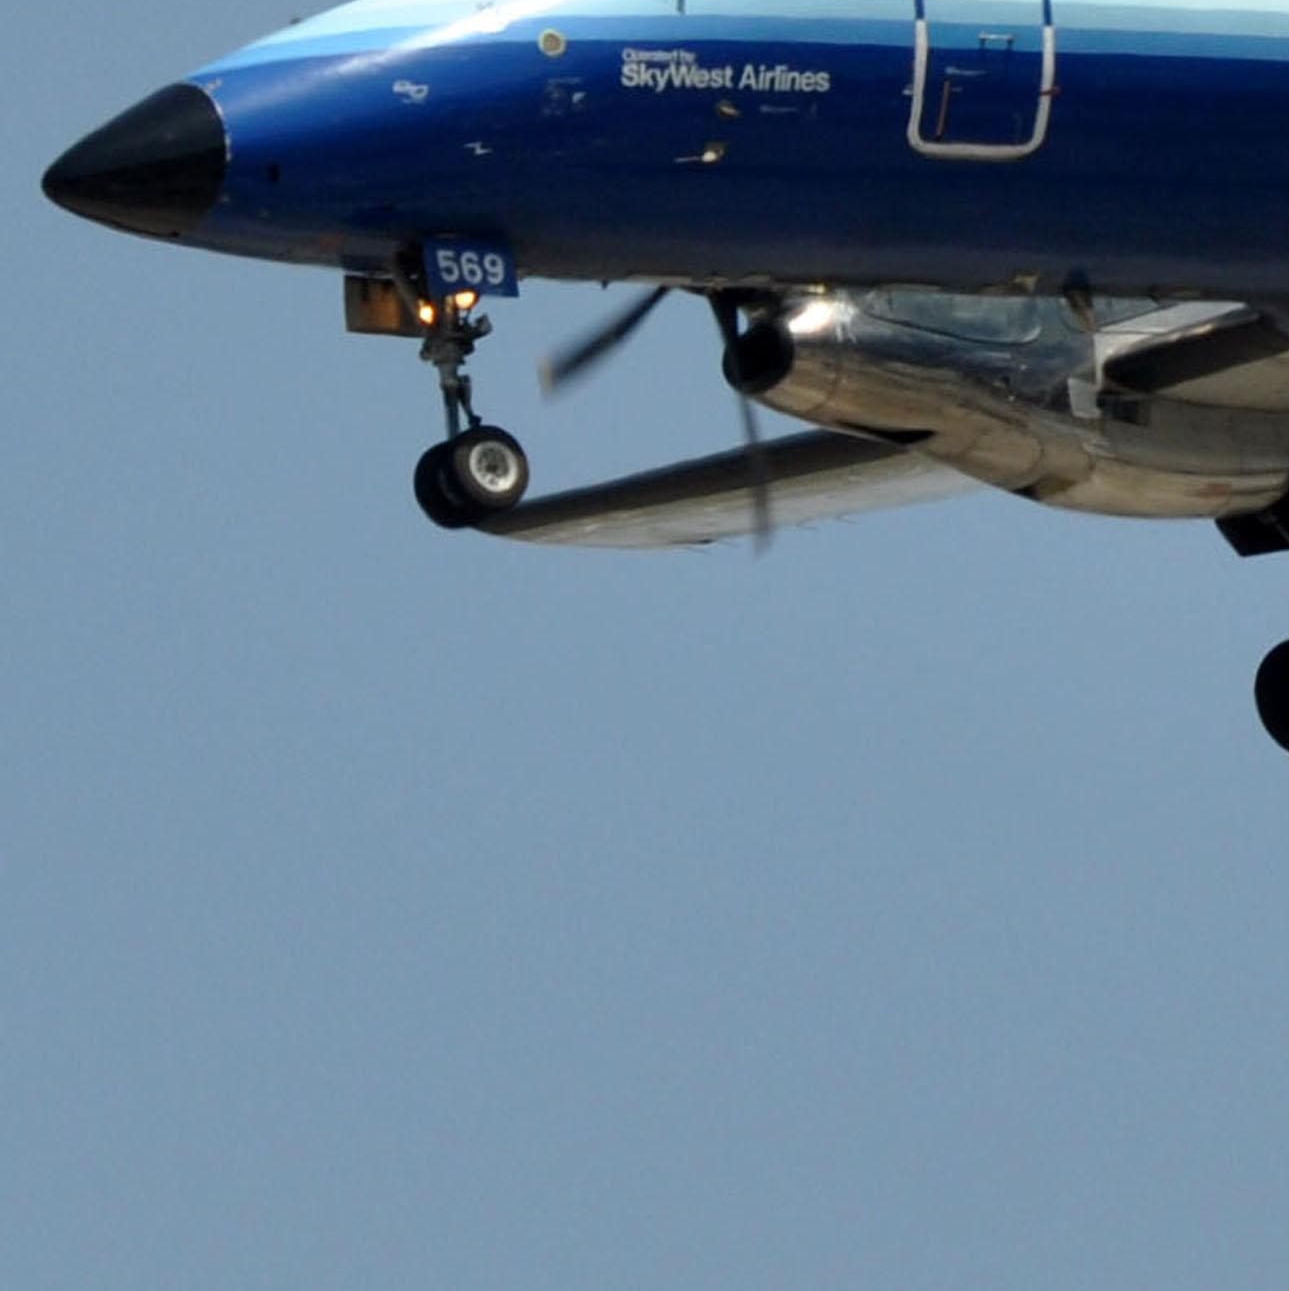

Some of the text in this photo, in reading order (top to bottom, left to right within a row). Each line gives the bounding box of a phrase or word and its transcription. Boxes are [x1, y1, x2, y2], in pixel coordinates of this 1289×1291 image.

[621, 65, 830, 91] SkyWest Airlines
[436, 251, 505, 284] 569
